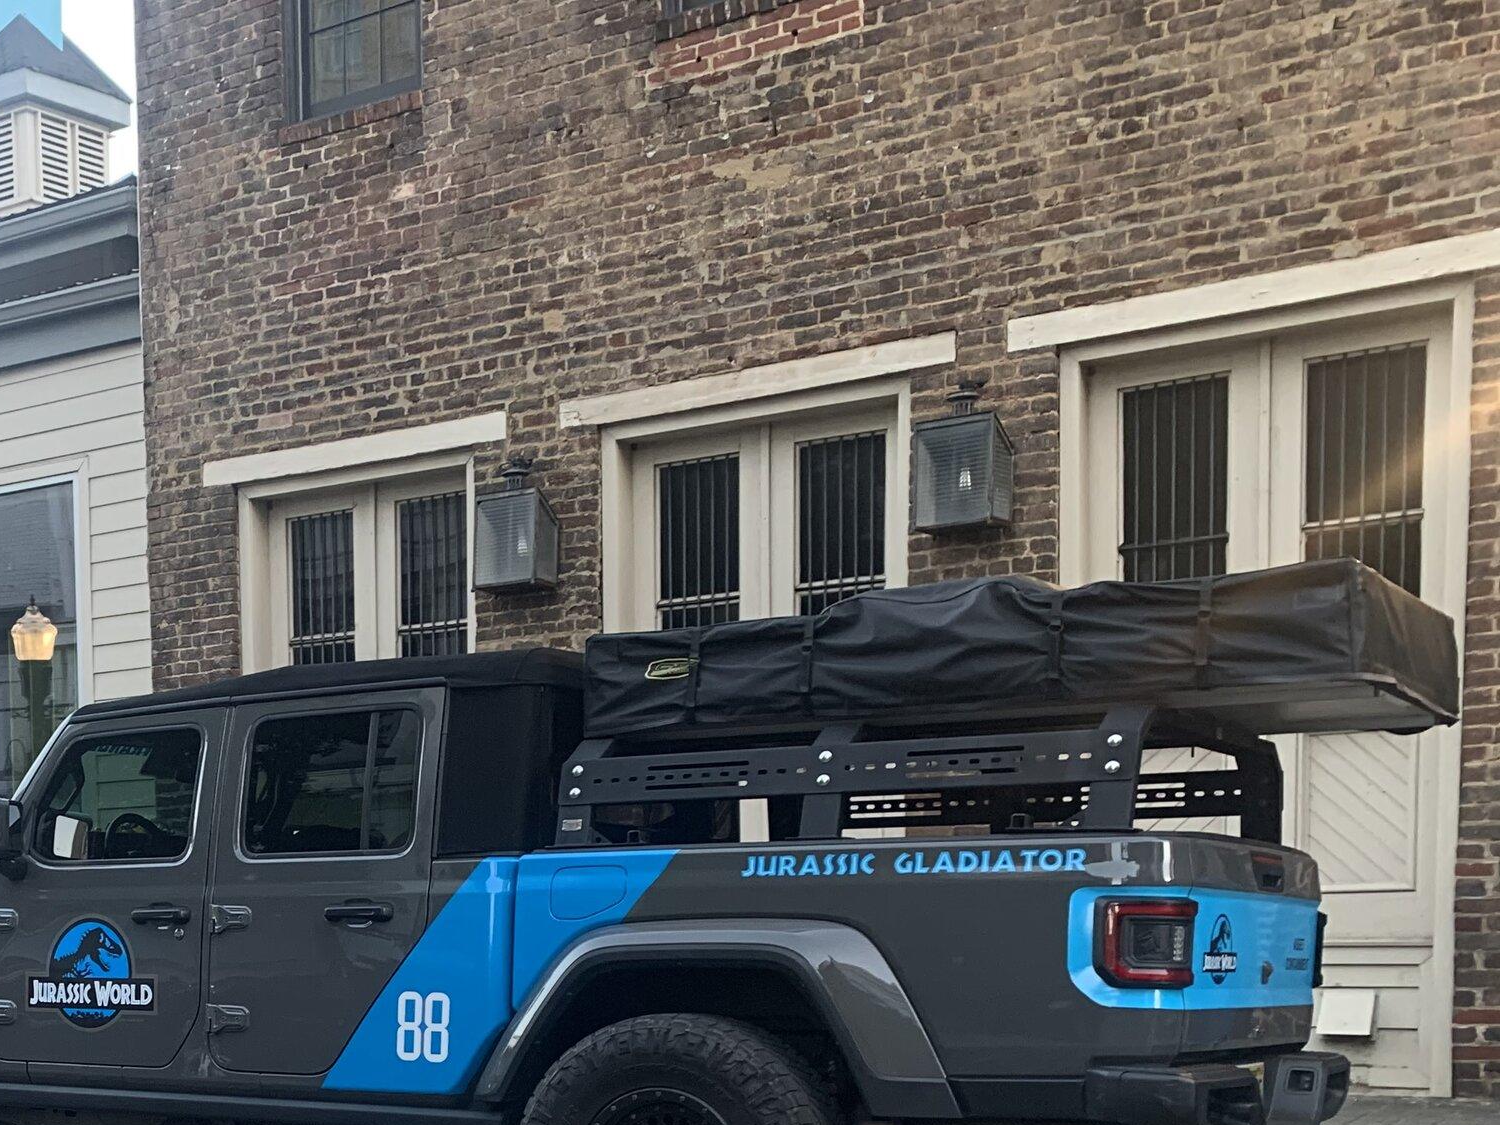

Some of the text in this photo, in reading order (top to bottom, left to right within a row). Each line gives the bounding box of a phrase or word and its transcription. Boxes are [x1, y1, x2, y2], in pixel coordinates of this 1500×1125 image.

[741, 848, 1087, 877] JURASSIC GLADIATOR
[30, 979, 153, 1007] JURASSIC WORLD
[396, 990, 451, 1063] 88
